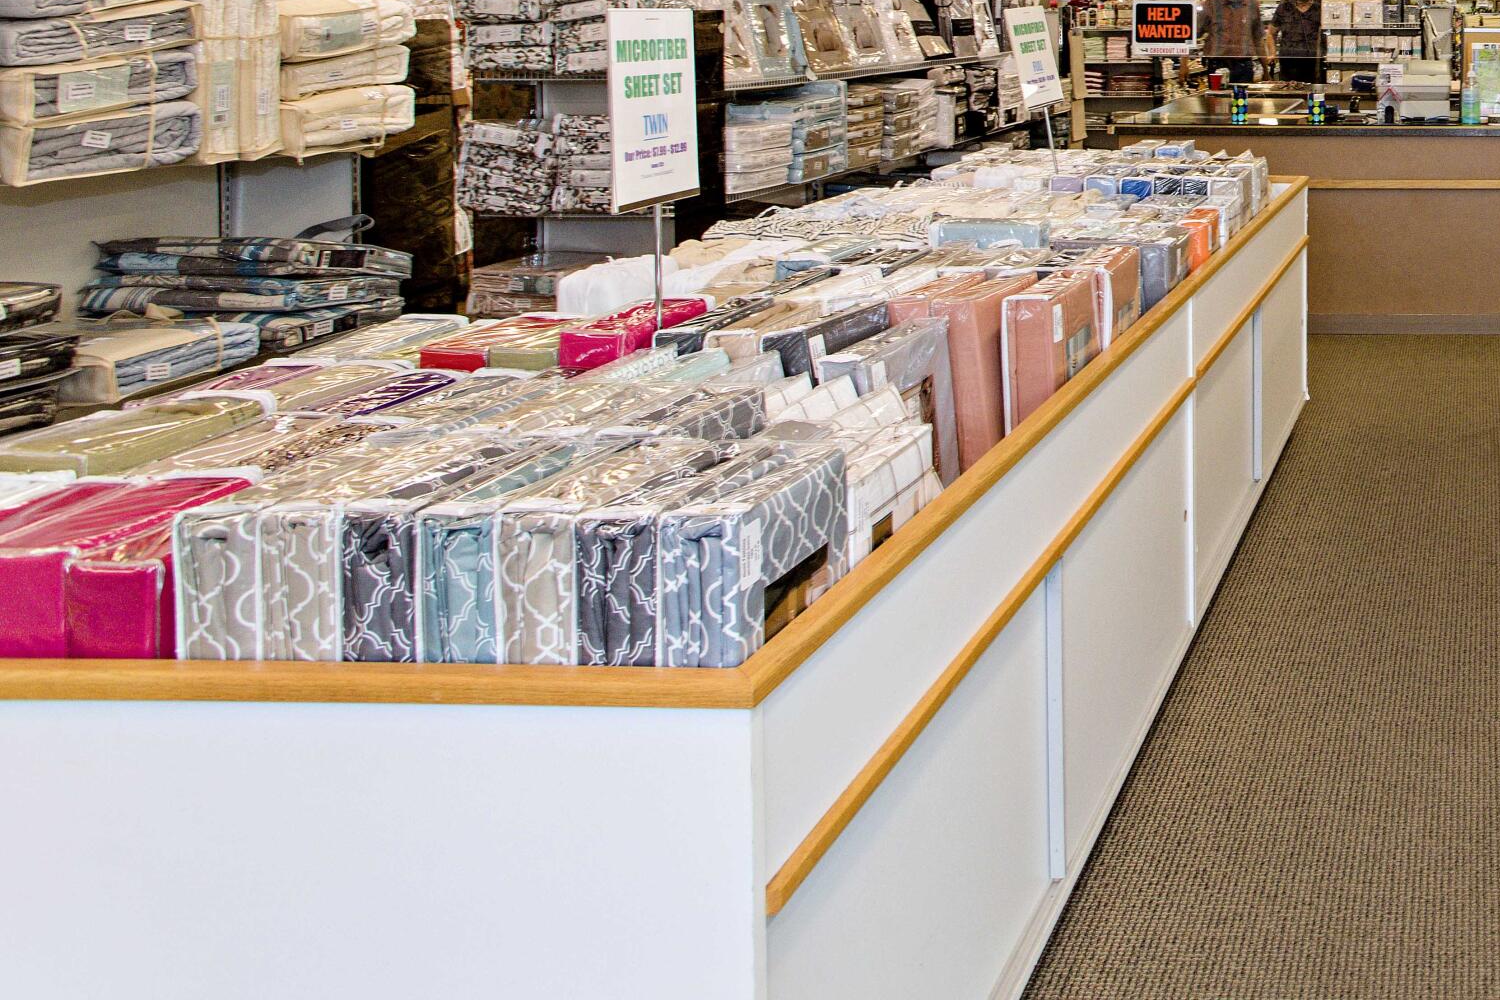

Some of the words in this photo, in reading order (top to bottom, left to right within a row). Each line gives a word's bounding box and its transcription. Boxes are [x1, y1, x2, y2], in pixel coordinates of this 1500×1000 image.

[1147, 7, 1181, 21] HELP
[1137, 24, 1191, 39] WANTED
[616, 38, 688, 63] MICROFIBER
[624, 74, 660, 99] SHEET
[663, 72, 682, 95] SET
[642, 113, 668, 136] TWIN
